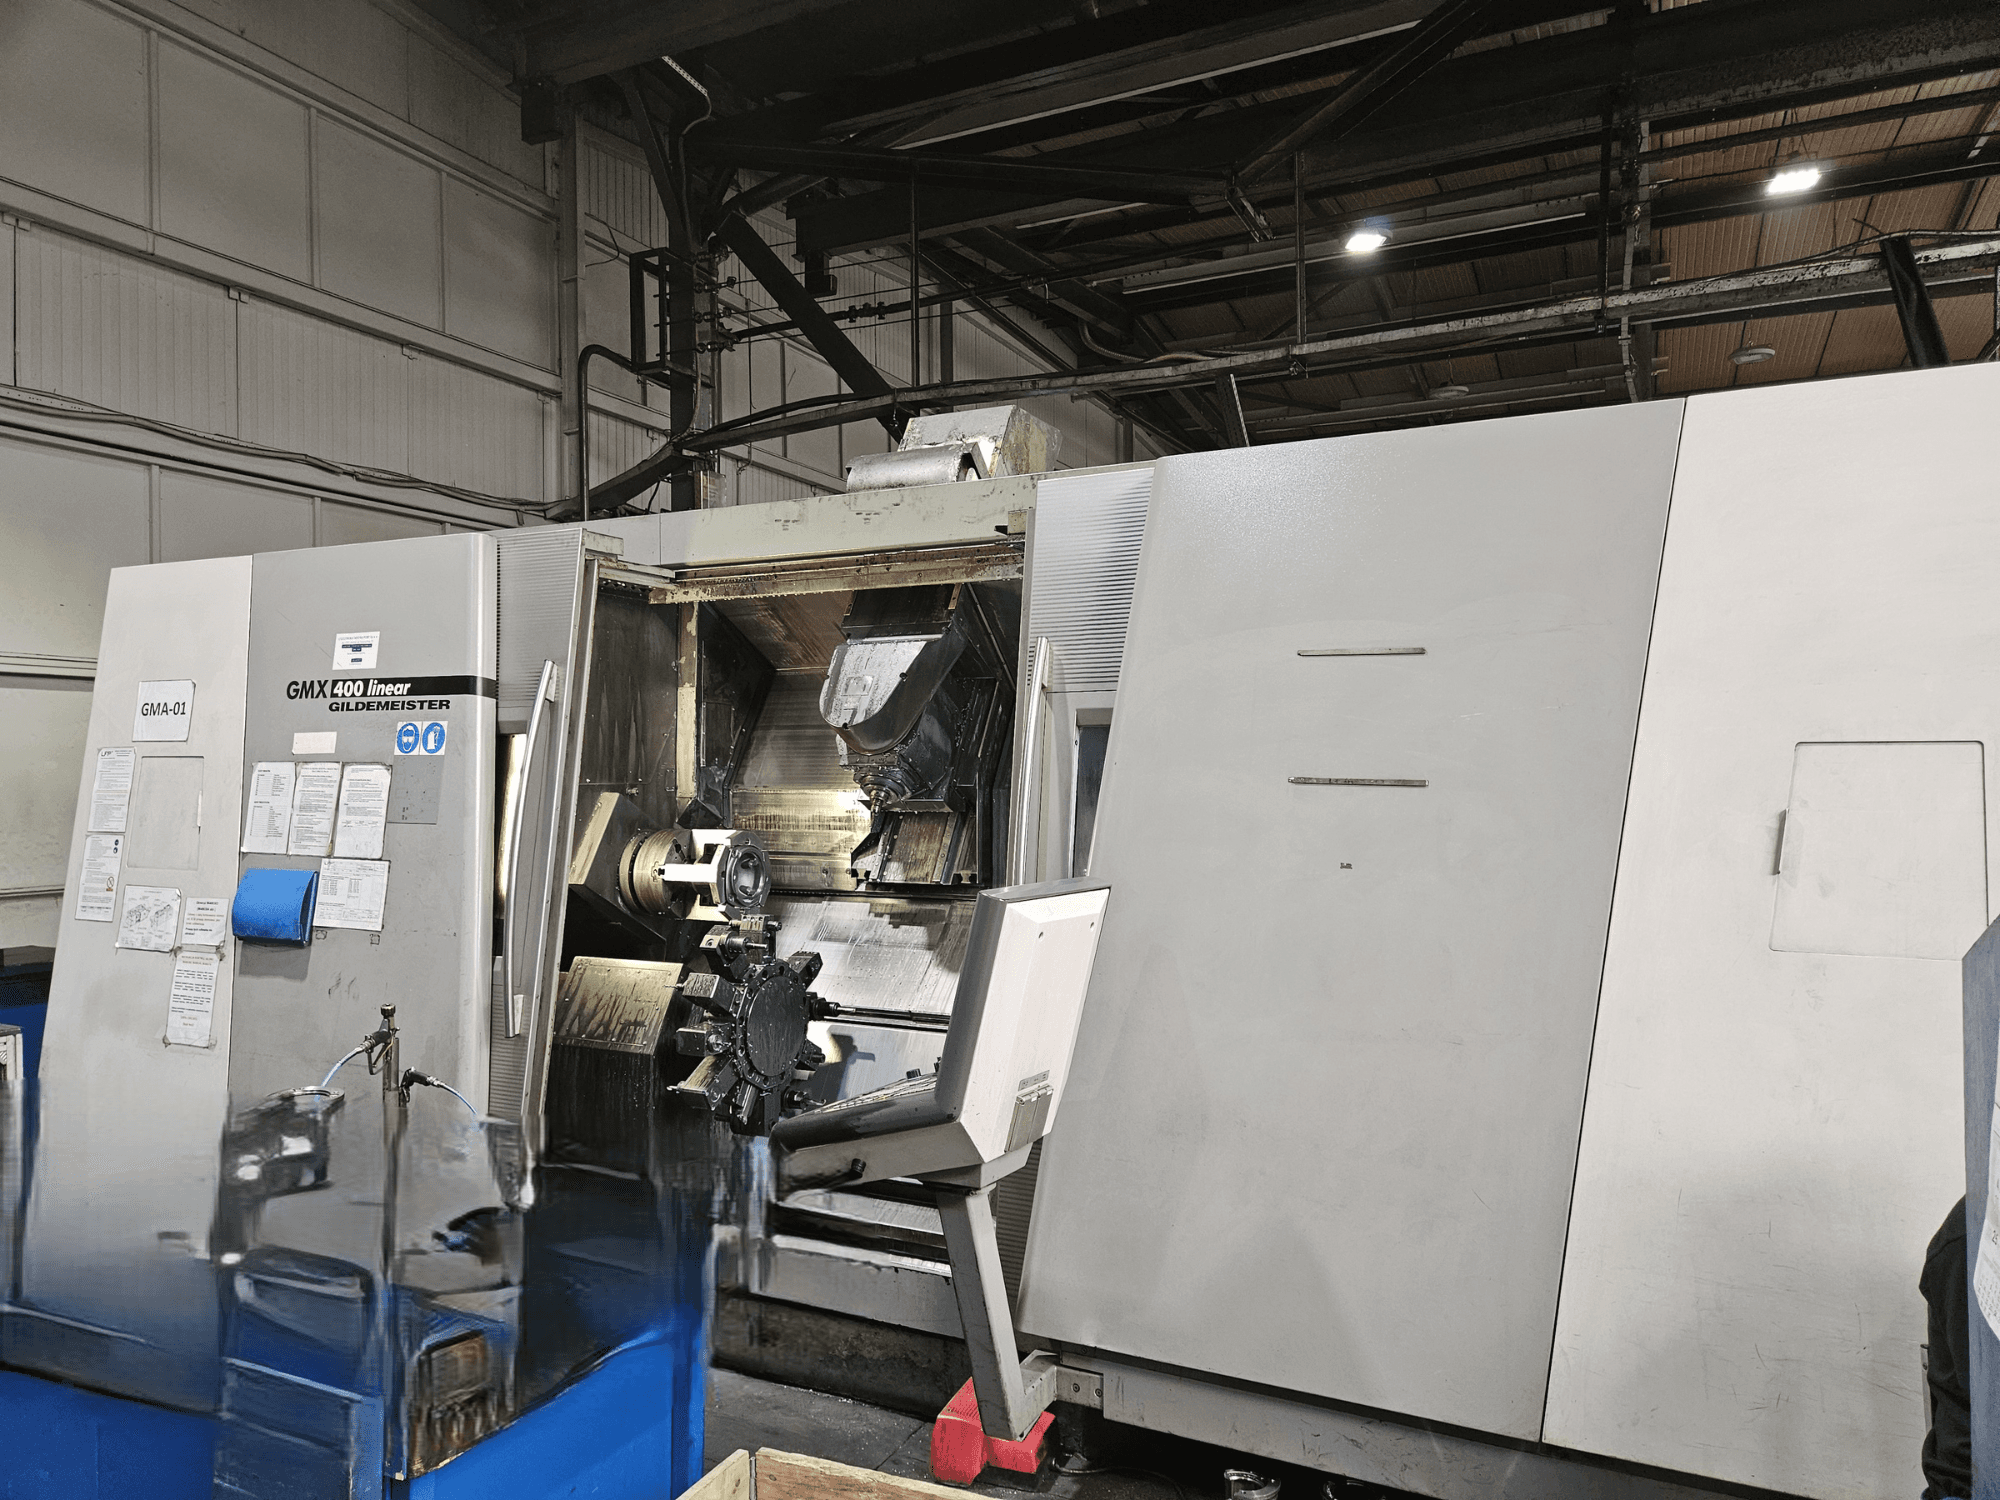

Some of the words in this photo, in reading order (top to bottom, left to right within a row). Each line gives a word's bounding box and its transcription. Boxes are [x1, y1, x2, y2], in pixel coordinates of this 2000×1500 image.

[287, 680, 329, 700] GMX
[333, 680, 364, 697] 400
[367, 679, 411, 696] linear
[141, 701, 186, 717] GMA-01
[328, 699, 451, 712] GILDEMEISTER
